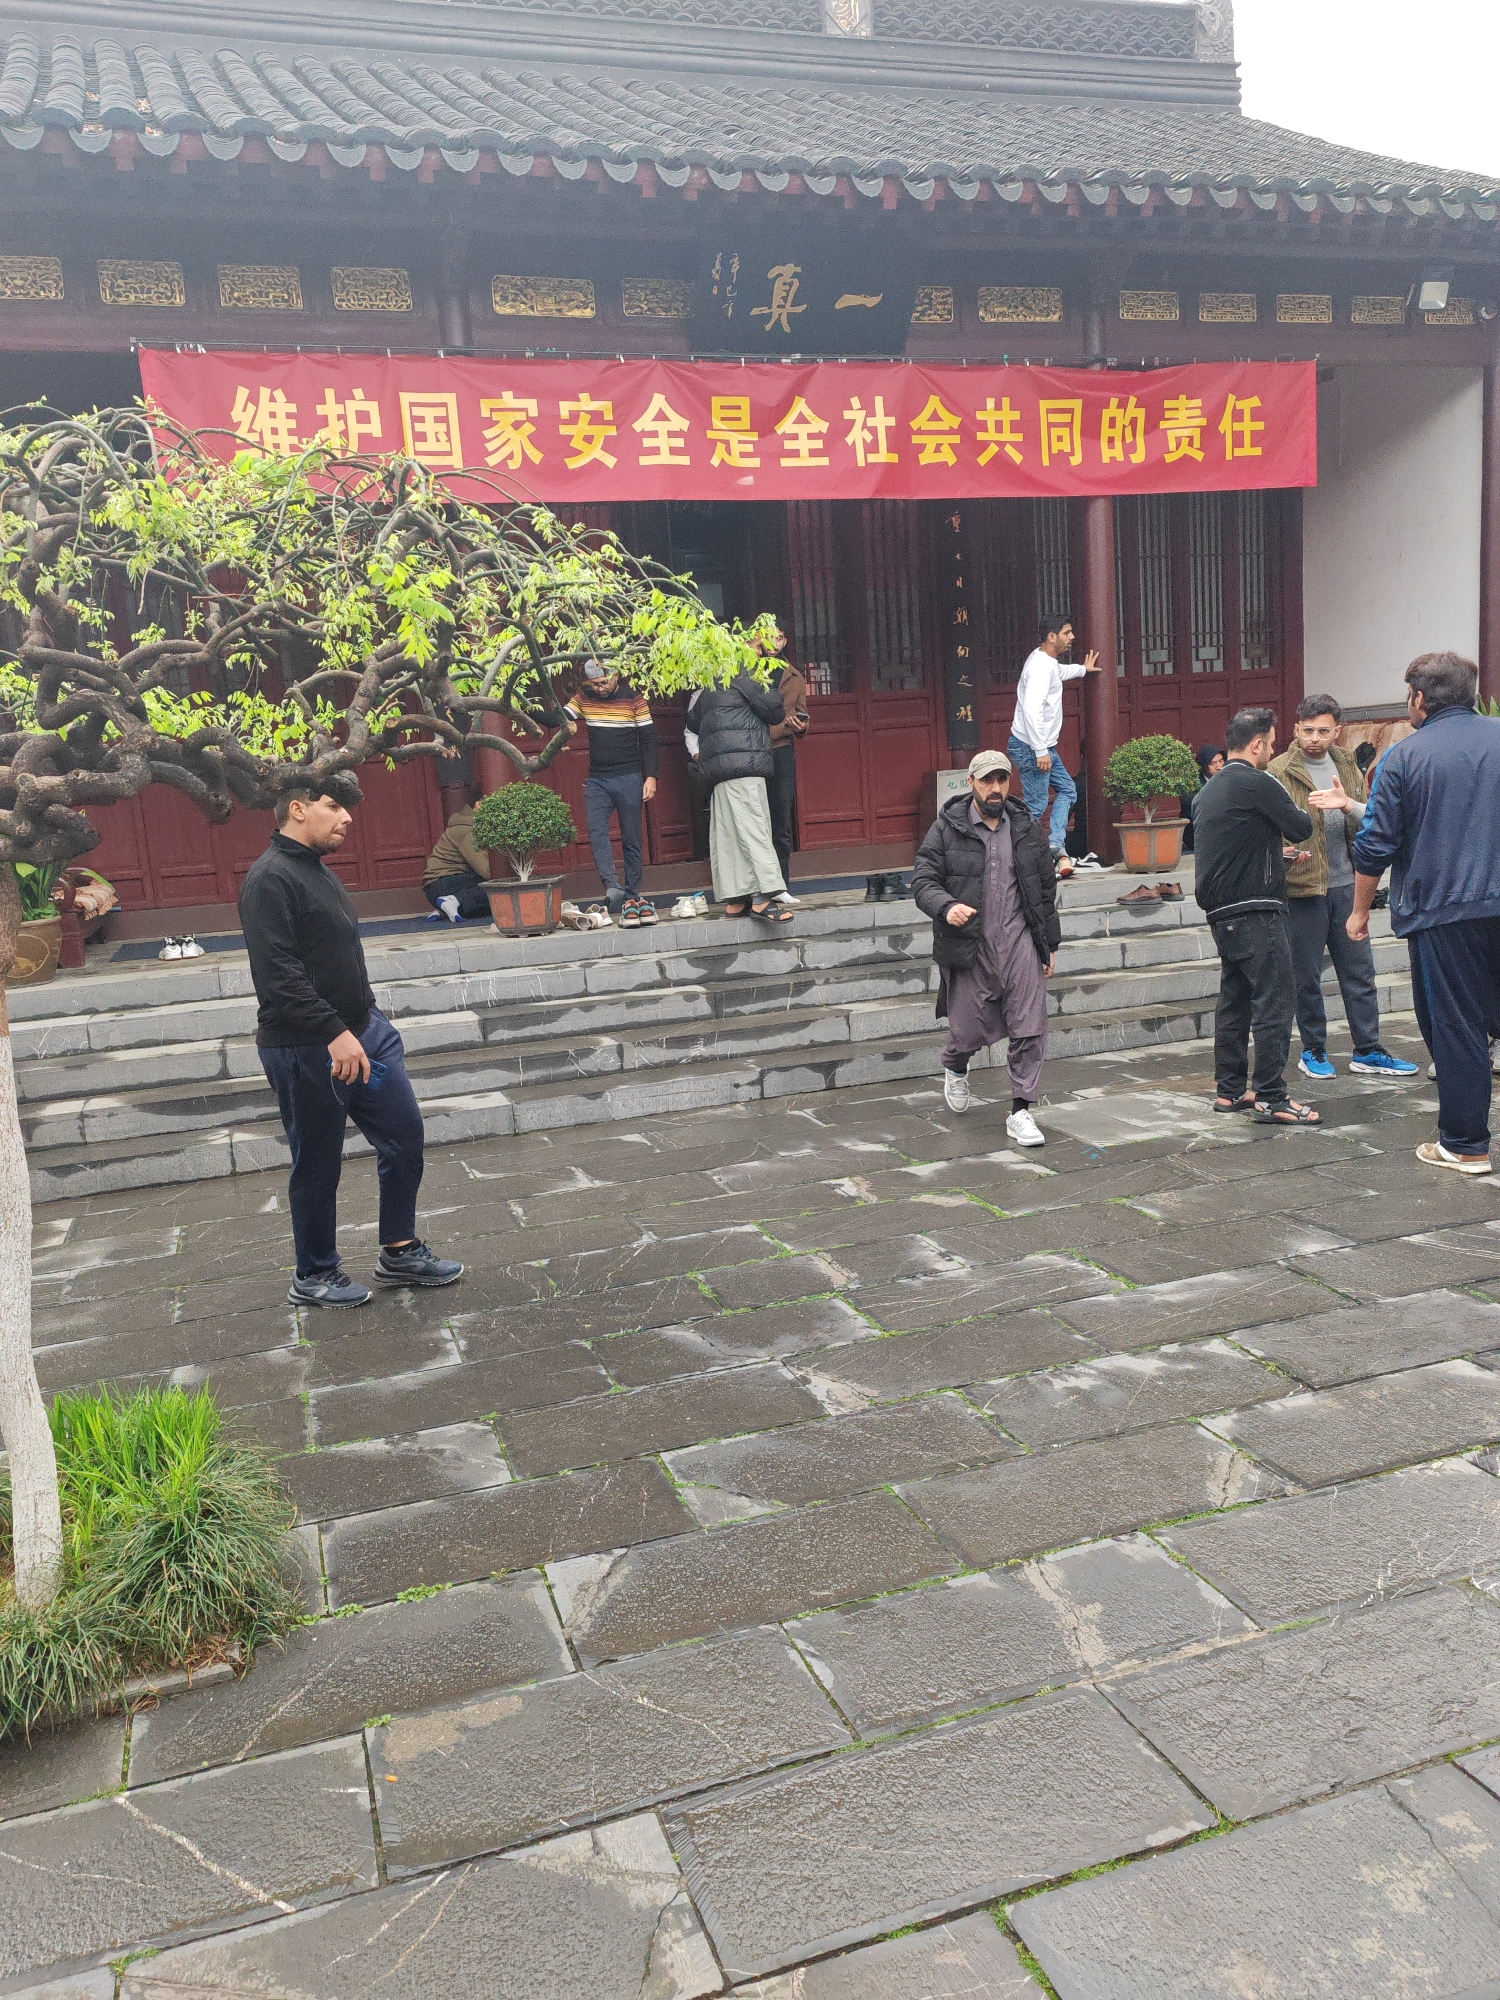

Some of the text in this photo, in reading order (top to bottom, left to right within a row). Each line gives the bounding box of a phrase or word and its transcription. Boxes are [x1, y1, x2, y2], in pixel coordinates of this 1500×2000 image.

[230, 385, 1265, 470] 维护国家安全是全社会共同的责任
